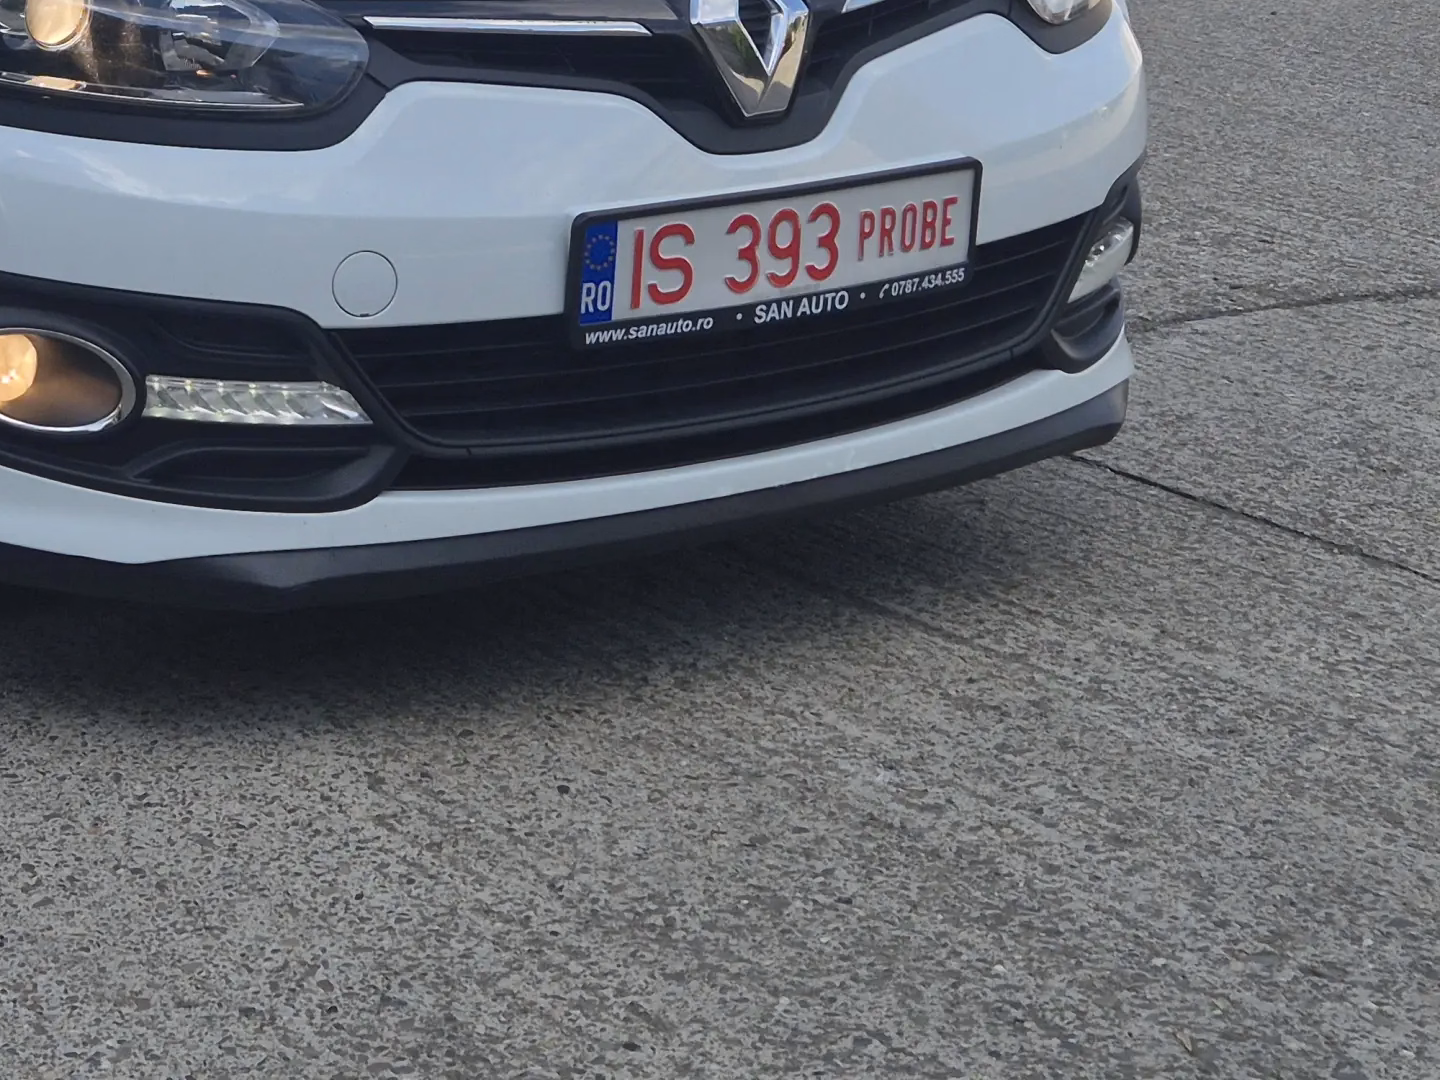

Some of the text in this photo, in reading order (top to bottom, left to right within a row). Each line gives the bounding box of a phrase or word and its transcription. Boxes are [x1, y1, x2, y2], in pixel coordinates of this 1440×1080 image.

[630, 197, 959, 310] IS 393 PROBE
[580, 281, 611, 314] RO
[584, 267, 965, 345] www.sanauto.ro SAN AUTO 0787.434.555
